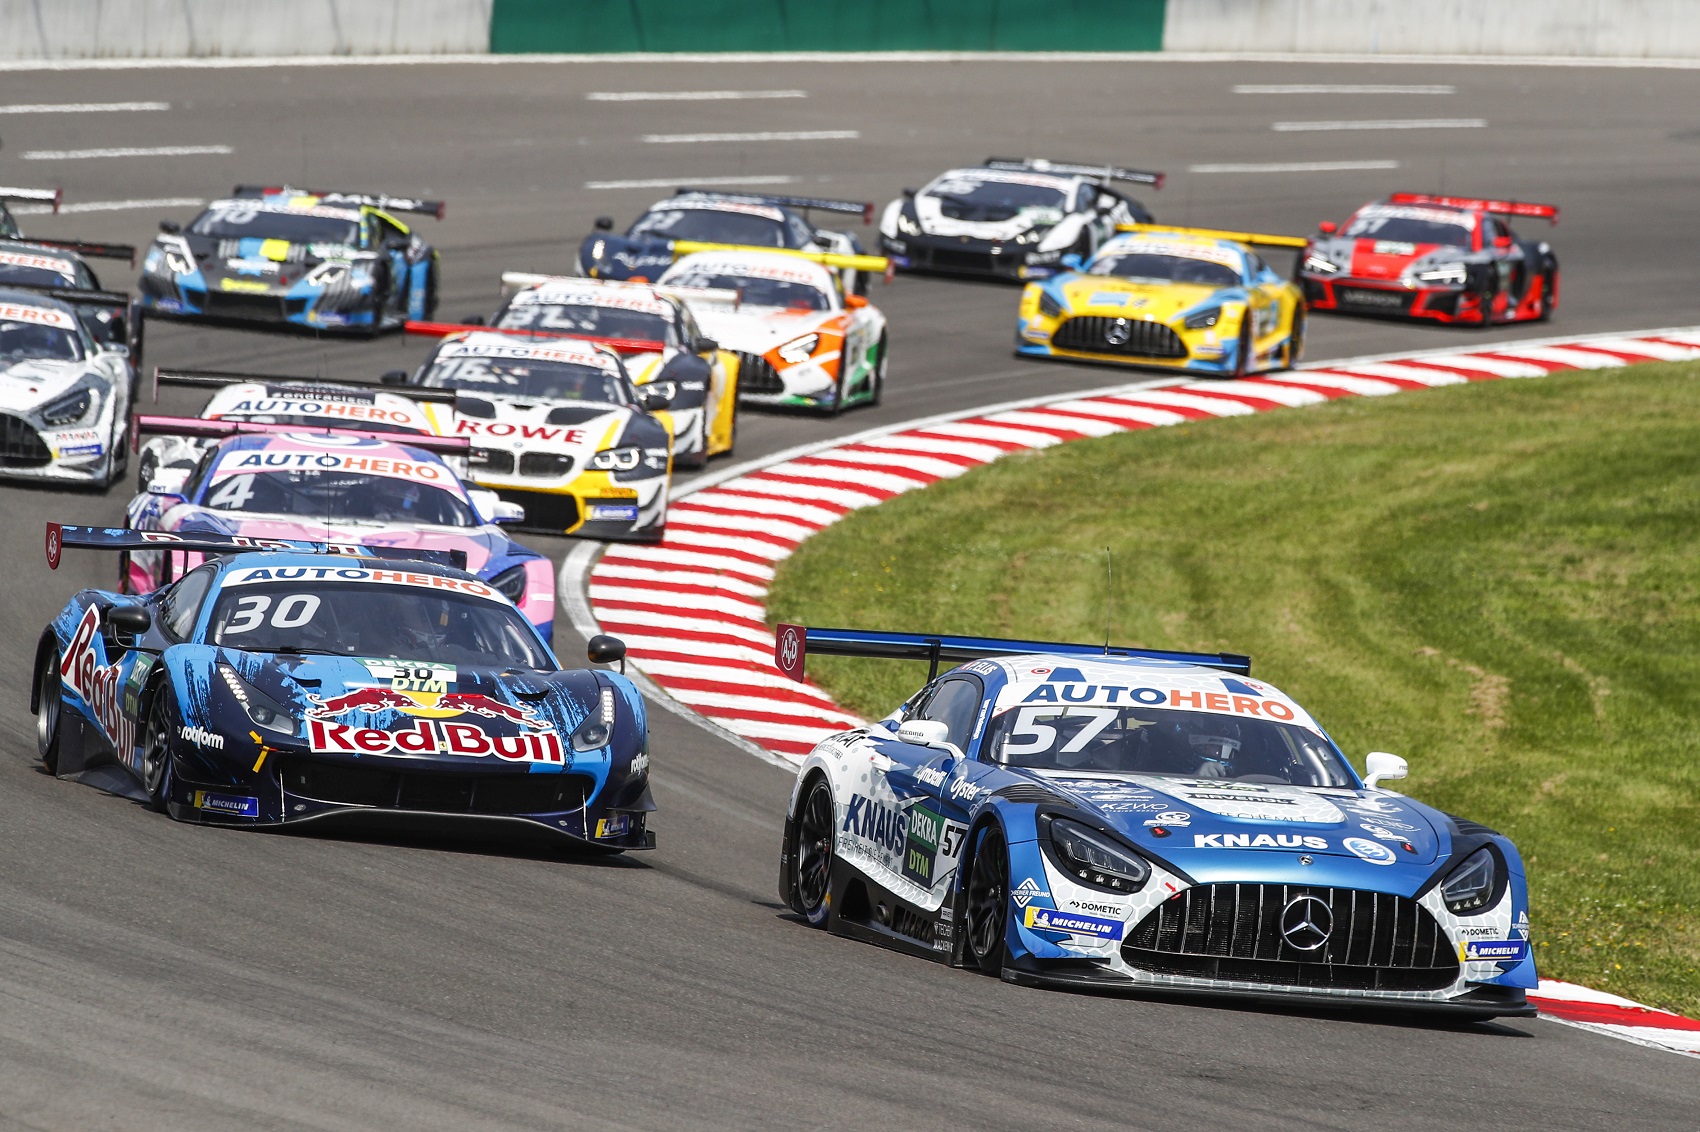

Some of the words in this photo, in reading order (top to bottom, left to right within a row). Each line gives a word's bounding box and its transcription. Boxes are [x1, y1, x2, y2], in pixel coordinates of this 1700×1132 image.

[0, 307, 61, 324] ERO
[457, 345, 608, 367] AUTOHERO
[233, 400, 411, 424] AUTOHERO
[456, 419, 588, 445] ROWE
[238, 453, 440, 480] AUTOHERO
[209, 473, 255, 510] 4
[241, 568, 492, 597] AUTOHERO
[223, 594, 321, 635] 30
[363, 659, 451, 671] DEKRA
[393, 667, 434, 681] 30
[391, 677, 448, 693] DTM
[1020, 684, 1295, 721] AUTOHERO
[181, 726, 224, 750] rotiform
[306, 718, 438, 754] Red
[443, 723, 564, 765] Bull
[1004, 707, 1119, 755] 57
[950, 775, 980, 801] Oyster
[211, 798, 249, 810] MICHELIN
[842, 793, 907, 857] KNAUS
[911, 809, 938, 847] DEKRA
[942, 825, 968, 859] 57
[1193, 833, 1329, 850] KNAUS
[908, 849, 929, 879] DTM
[1081, 902, 1122, 915] DOMETIC
[1051, 917, 1113, 934] MICHELIN
[1470, 927, 1499, 936] DOMETIC
[1479, 946, 1520, 955] MICHELIN
